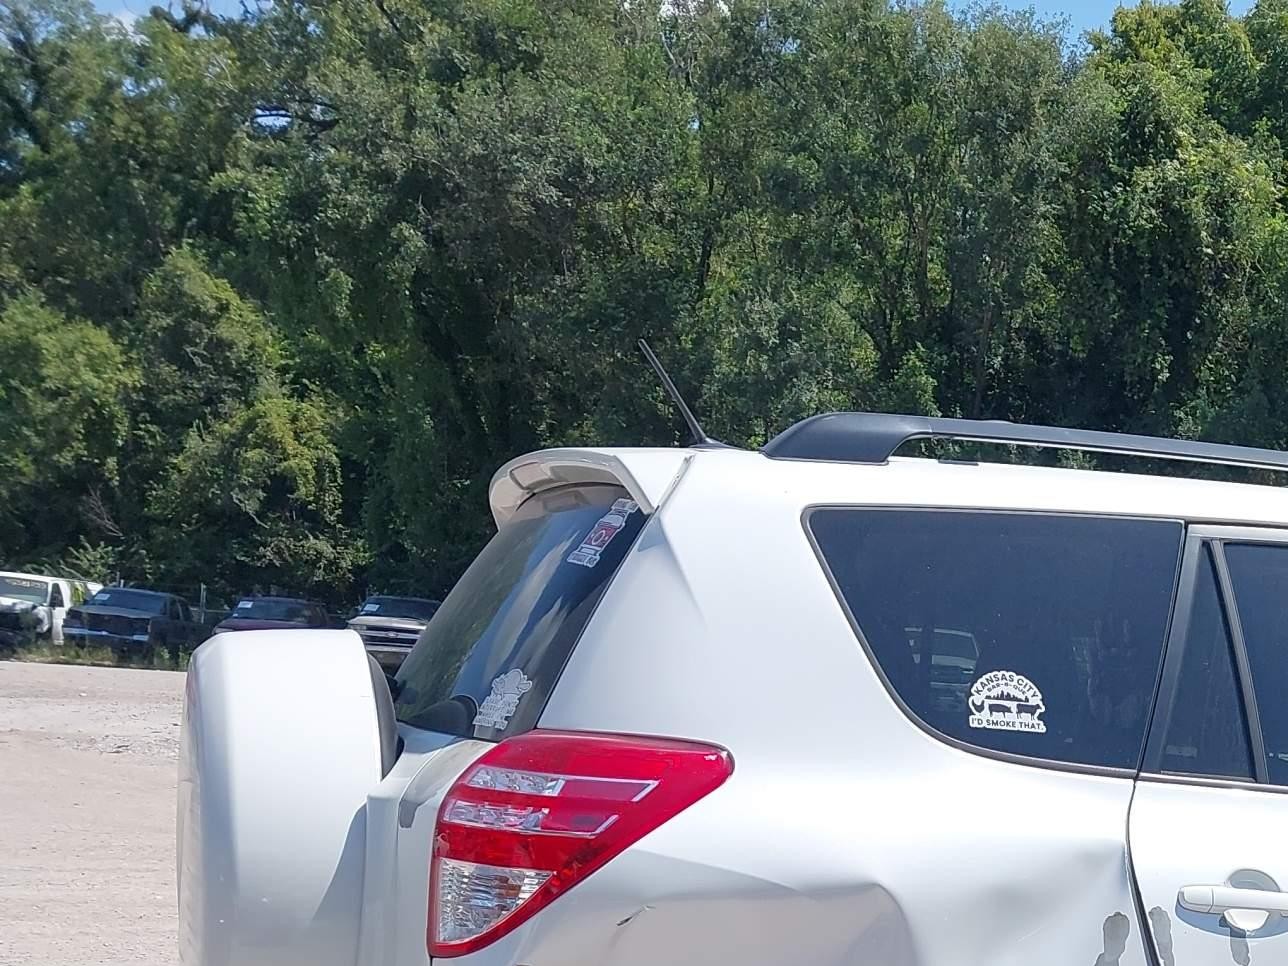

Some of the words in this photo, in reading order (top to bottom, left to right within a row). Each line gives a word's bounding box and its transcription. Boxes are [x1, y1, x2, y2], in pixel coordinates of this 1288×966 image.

[974, 673, 1014, 695] KANSAS
[1017, 679, 1038, 698] CITY
[987, 719, 1016, 728] SMOKE
